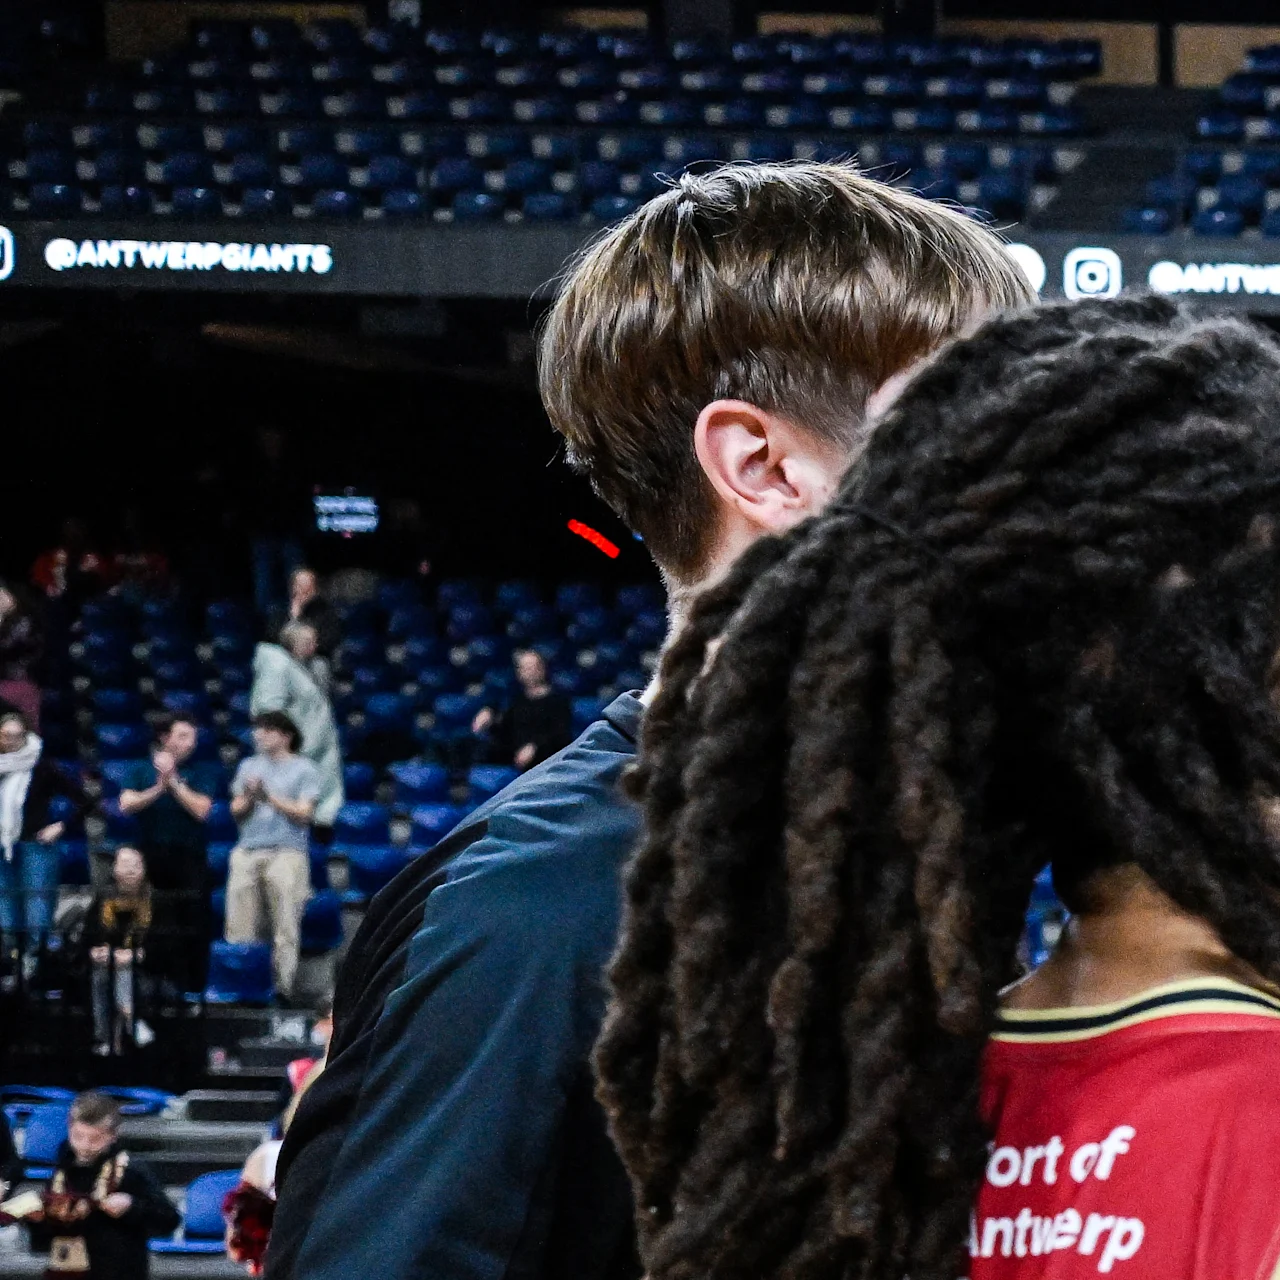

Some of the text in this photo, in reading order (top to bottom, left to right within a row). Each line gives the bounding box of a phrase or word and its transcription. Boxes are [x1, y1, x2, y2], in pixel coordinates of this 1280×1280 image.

[45, 237, 334, 275] @ANTWERPGIANTS
[985, 1124, 1138, 1188] ort of
